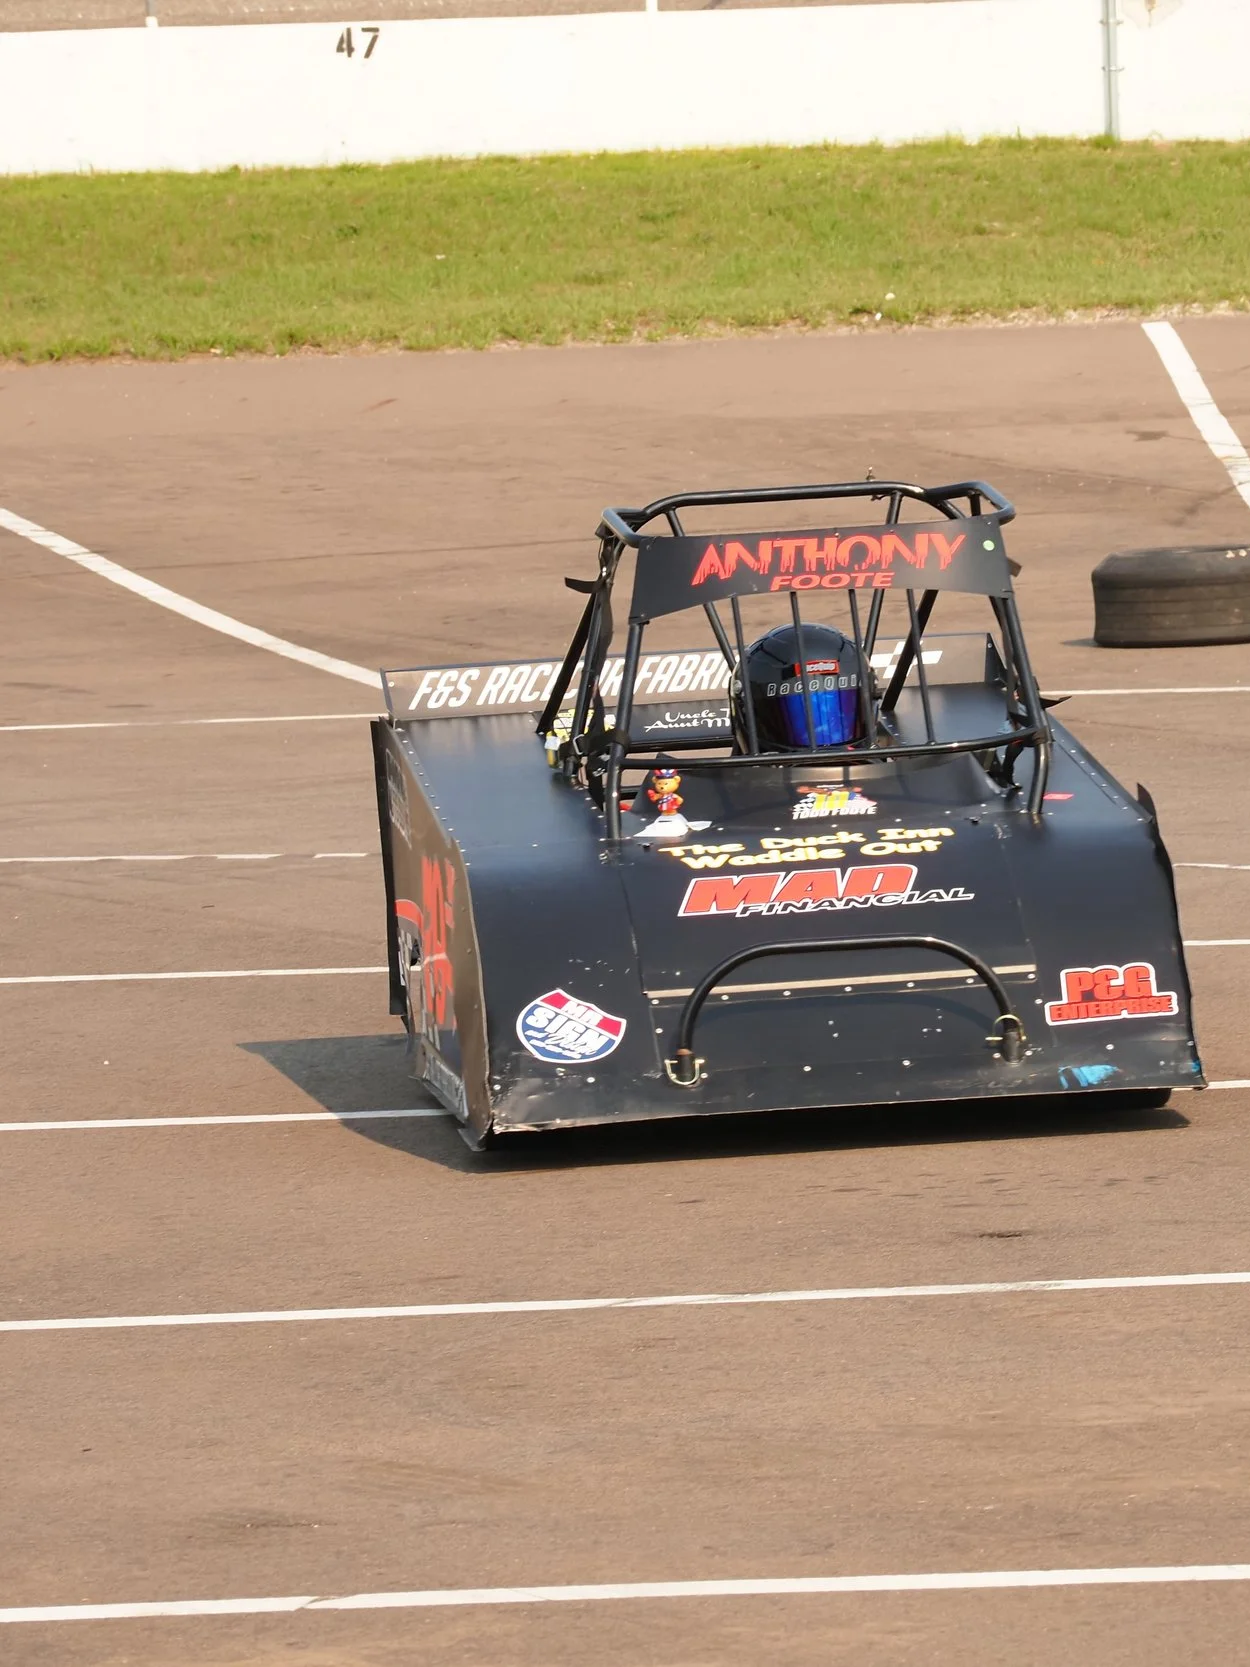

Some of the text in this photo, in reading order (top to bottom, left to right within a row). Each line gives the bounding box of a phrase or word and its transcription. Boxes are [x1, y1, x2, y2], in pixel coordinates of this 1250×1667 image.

[336, 27, 379, 58] 47
[691, 533, 966, 585] ANTHONY
[770, 571, 895, 591] FOOTE
[408, 669, 480, 710] F&S
[658, 827, 955, 856] The Duck Inn
[680, 839, 943, 869] Waddle Out
[678, 864, 918, 916] MAD
[735, 887, 975, 917] FINANCIAL
[1065, 966, 1152, 1003] P&G
[1050, 995, 1174, 1022] ENTERPRISE
